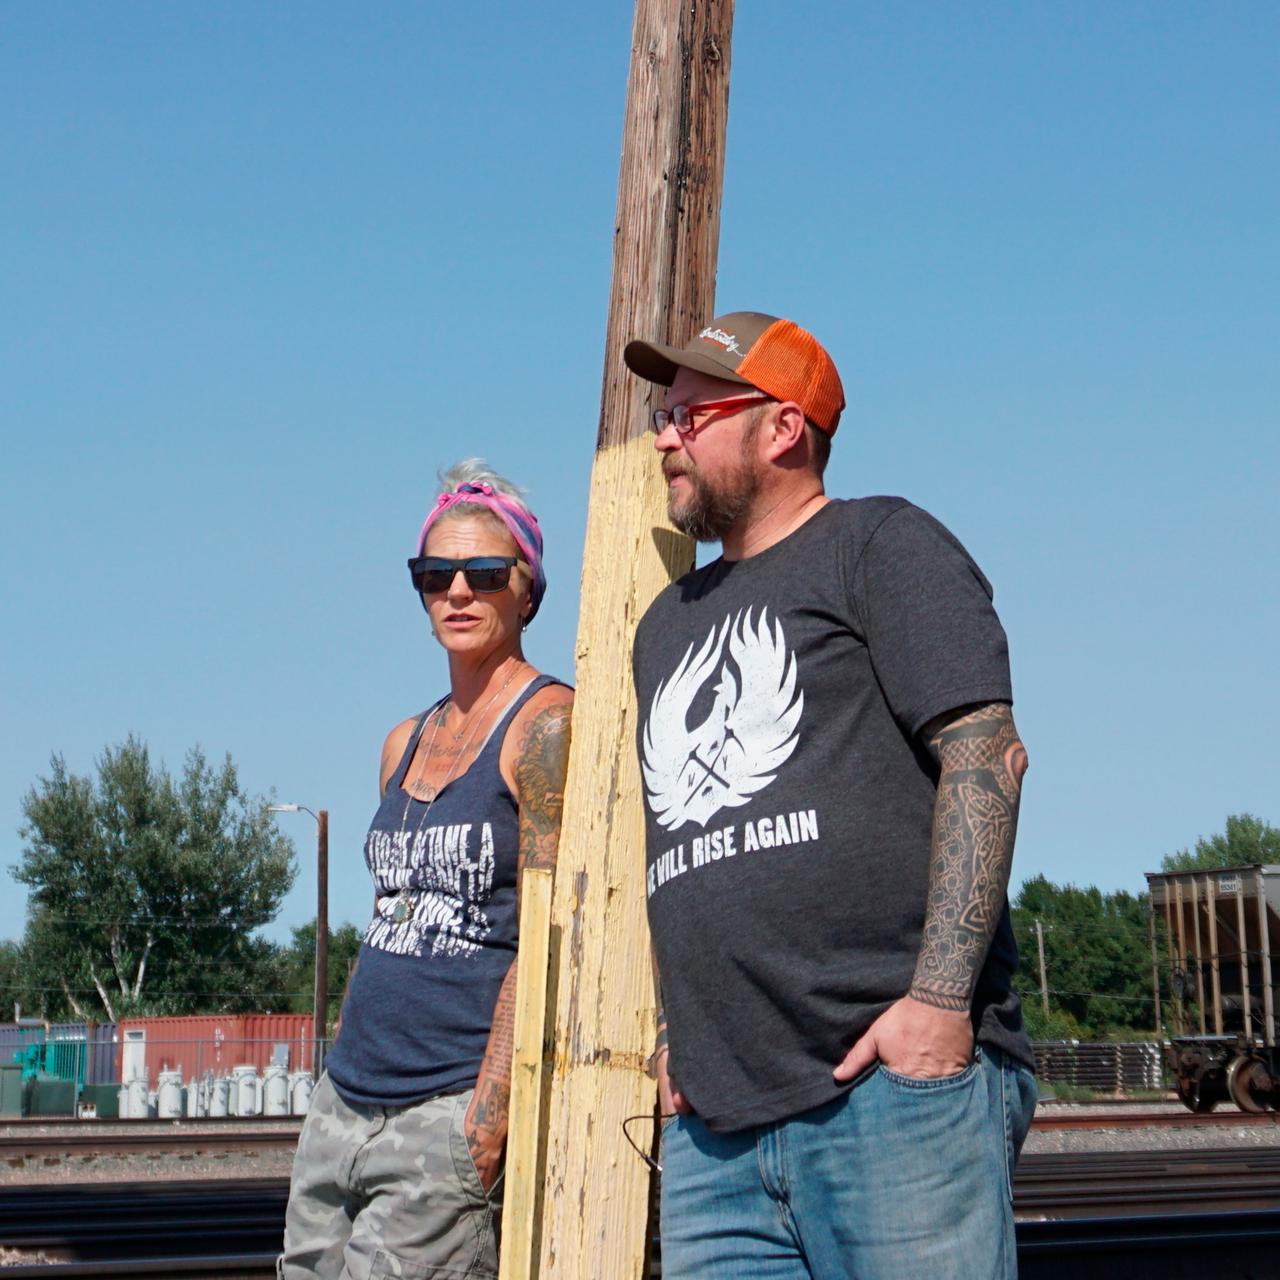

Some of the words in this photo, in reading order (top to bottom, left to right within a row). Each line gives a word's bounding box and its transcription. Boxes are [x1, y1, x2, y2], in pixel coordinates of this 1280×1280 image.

[656, 843, 688, 887] WILL
[692, 825, 737, 869] RISE
[744, 809, 819, 853] AGAIN
